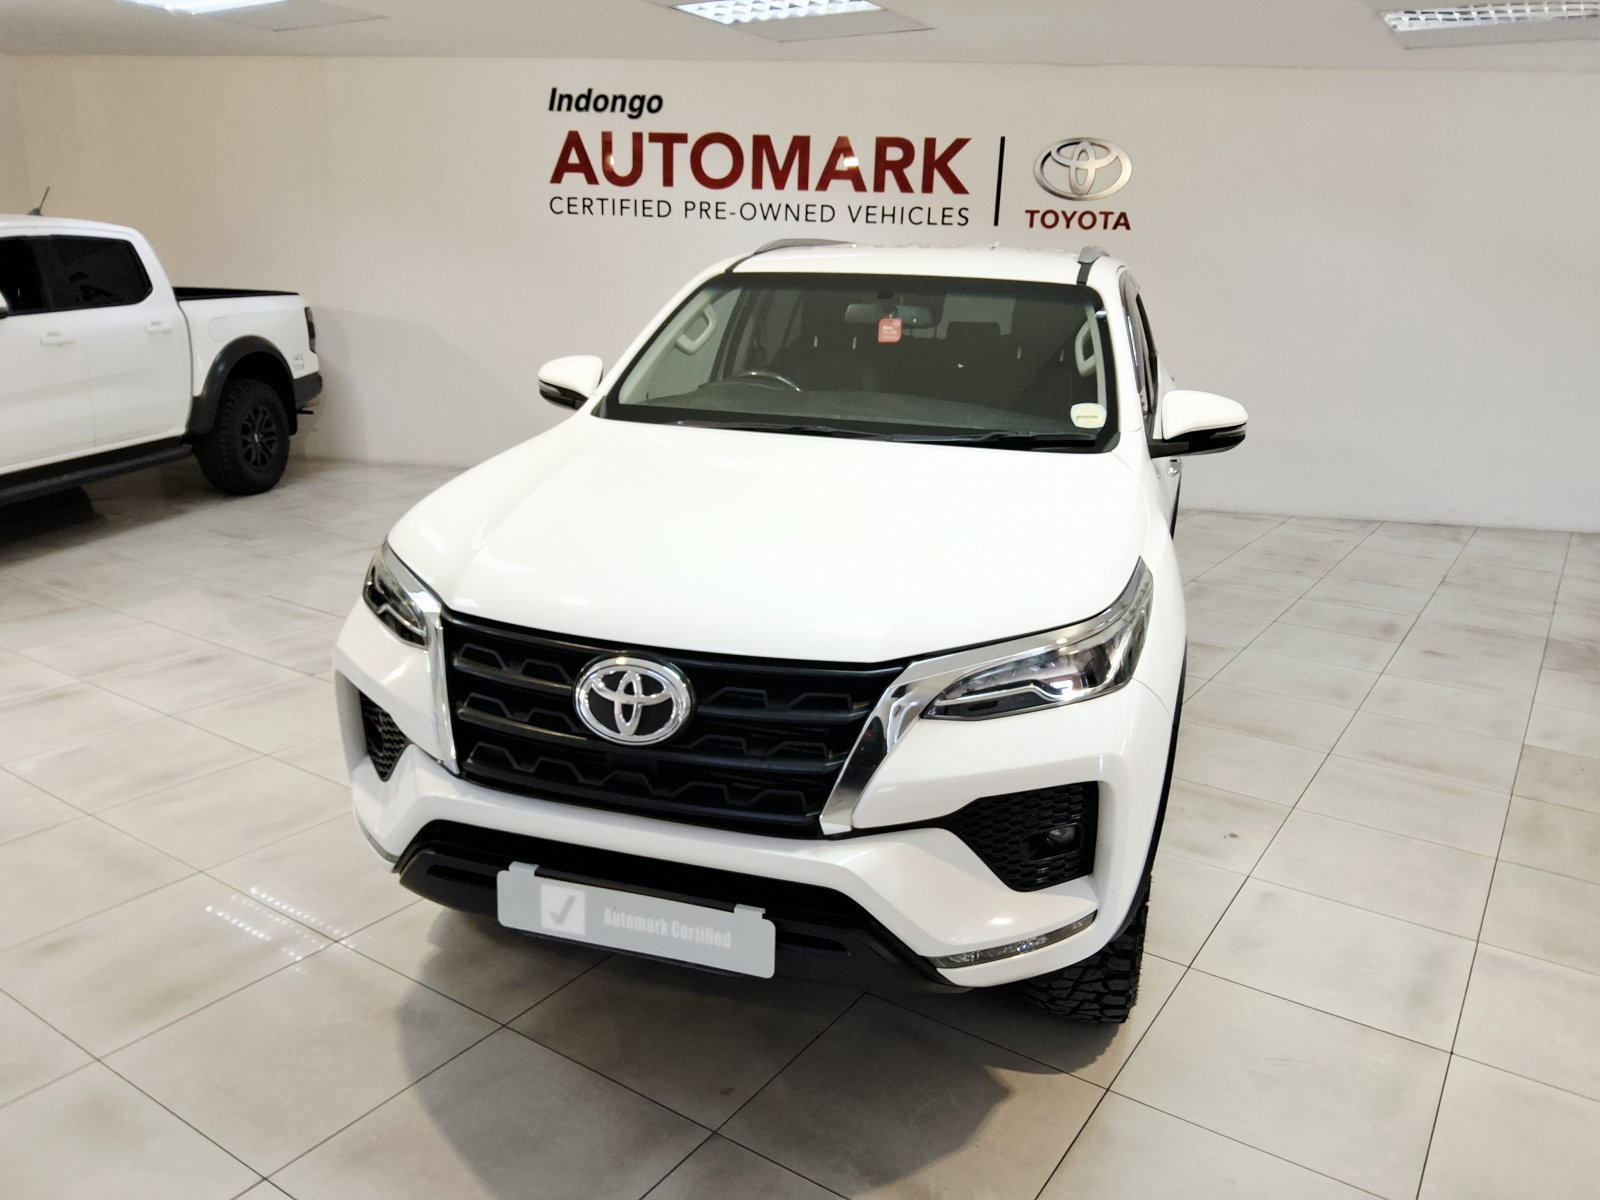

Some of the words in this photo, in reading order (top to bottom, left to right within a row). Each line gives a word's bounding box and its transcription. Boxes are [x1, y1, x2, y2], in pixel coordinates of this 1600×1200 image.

[548, 87, 664, 119] Indongo
[549, 130, 972, 195] AUTOMARK
[549, 196, 672, 218] CERTIFIED
[684, 201, 836, 222] PRE-OWNED
[848, 205, 970, 226] VEHICLES
[1025, 209, 1132, 231] TOYOTA
[604, 908, 668, 935] Automark
[671, 921, 732, 948] Certified
